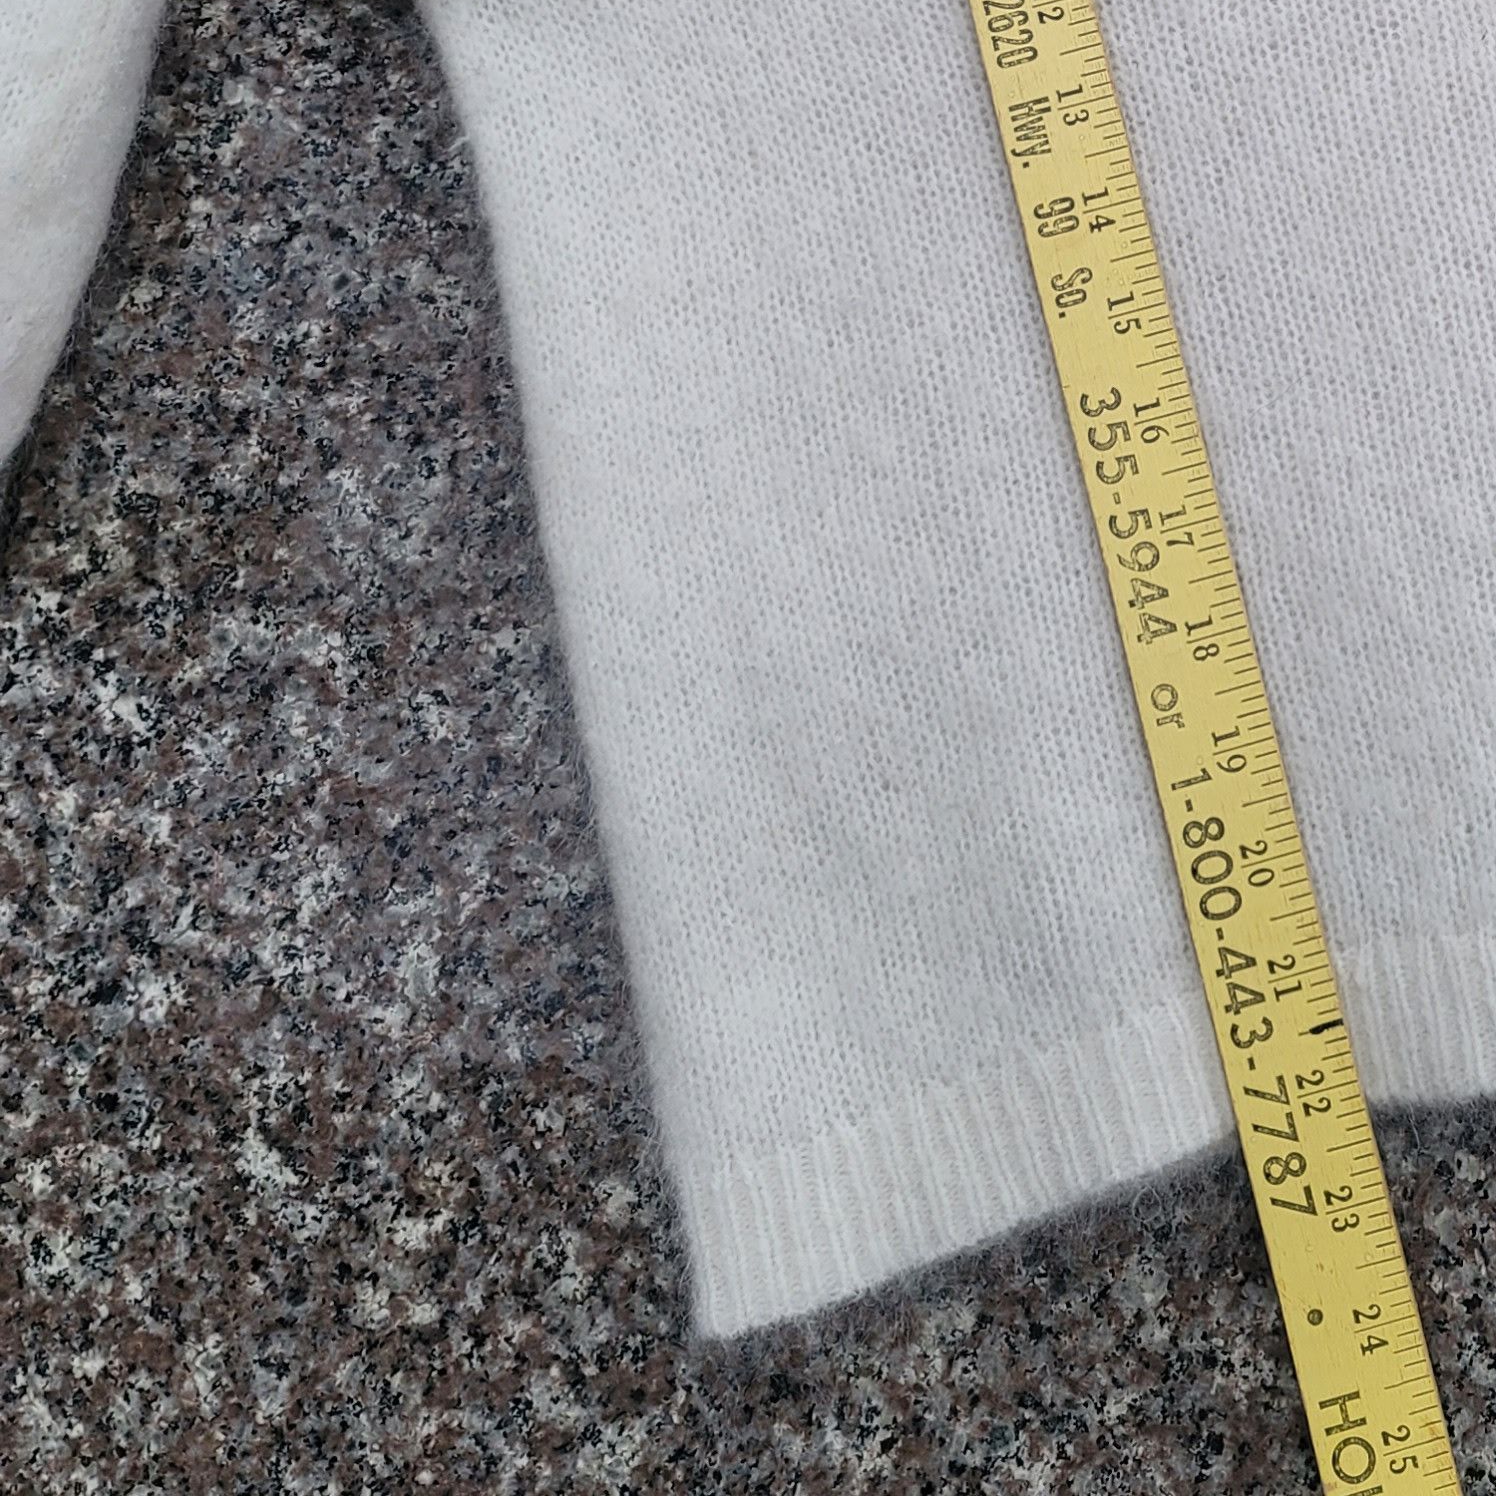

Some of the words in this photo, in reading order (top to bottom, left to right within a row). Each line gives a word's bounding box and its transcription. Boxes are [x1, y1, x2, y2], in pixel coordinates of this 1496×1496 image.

[1007, 95, 1053, 170] Hwy.
[1032, 195, 1081, 239] 99
[1049, 266, 1094, 320] So.
[1078, 386, 1179, 646] 355-5944
[1149, 682, 1187, 730] or
[1054, 83, 1091, 128] 13
[1080, 186, 1117, 235] 14
[1105, 291, 1143, 336] 15
[1132, 396, 1169, 445] 16
[1157, 503, 1196, 548] 17
[1183, 614, 1221, 662] 18
[1210, 725, 1248, 774] 19
[1237, 838, 1276, 888] 20
[1265, 953, 1304, 1003] 21
[1294, 1068, 1333, 1118] 22
[1322, 1184, 1361, 1233] 23
[1351, 1303, 1390, 1357] 24
[1380, 1423, 1420, 1475] 25
[1170, 767, 1319, 1218] 1-800-443-7787
